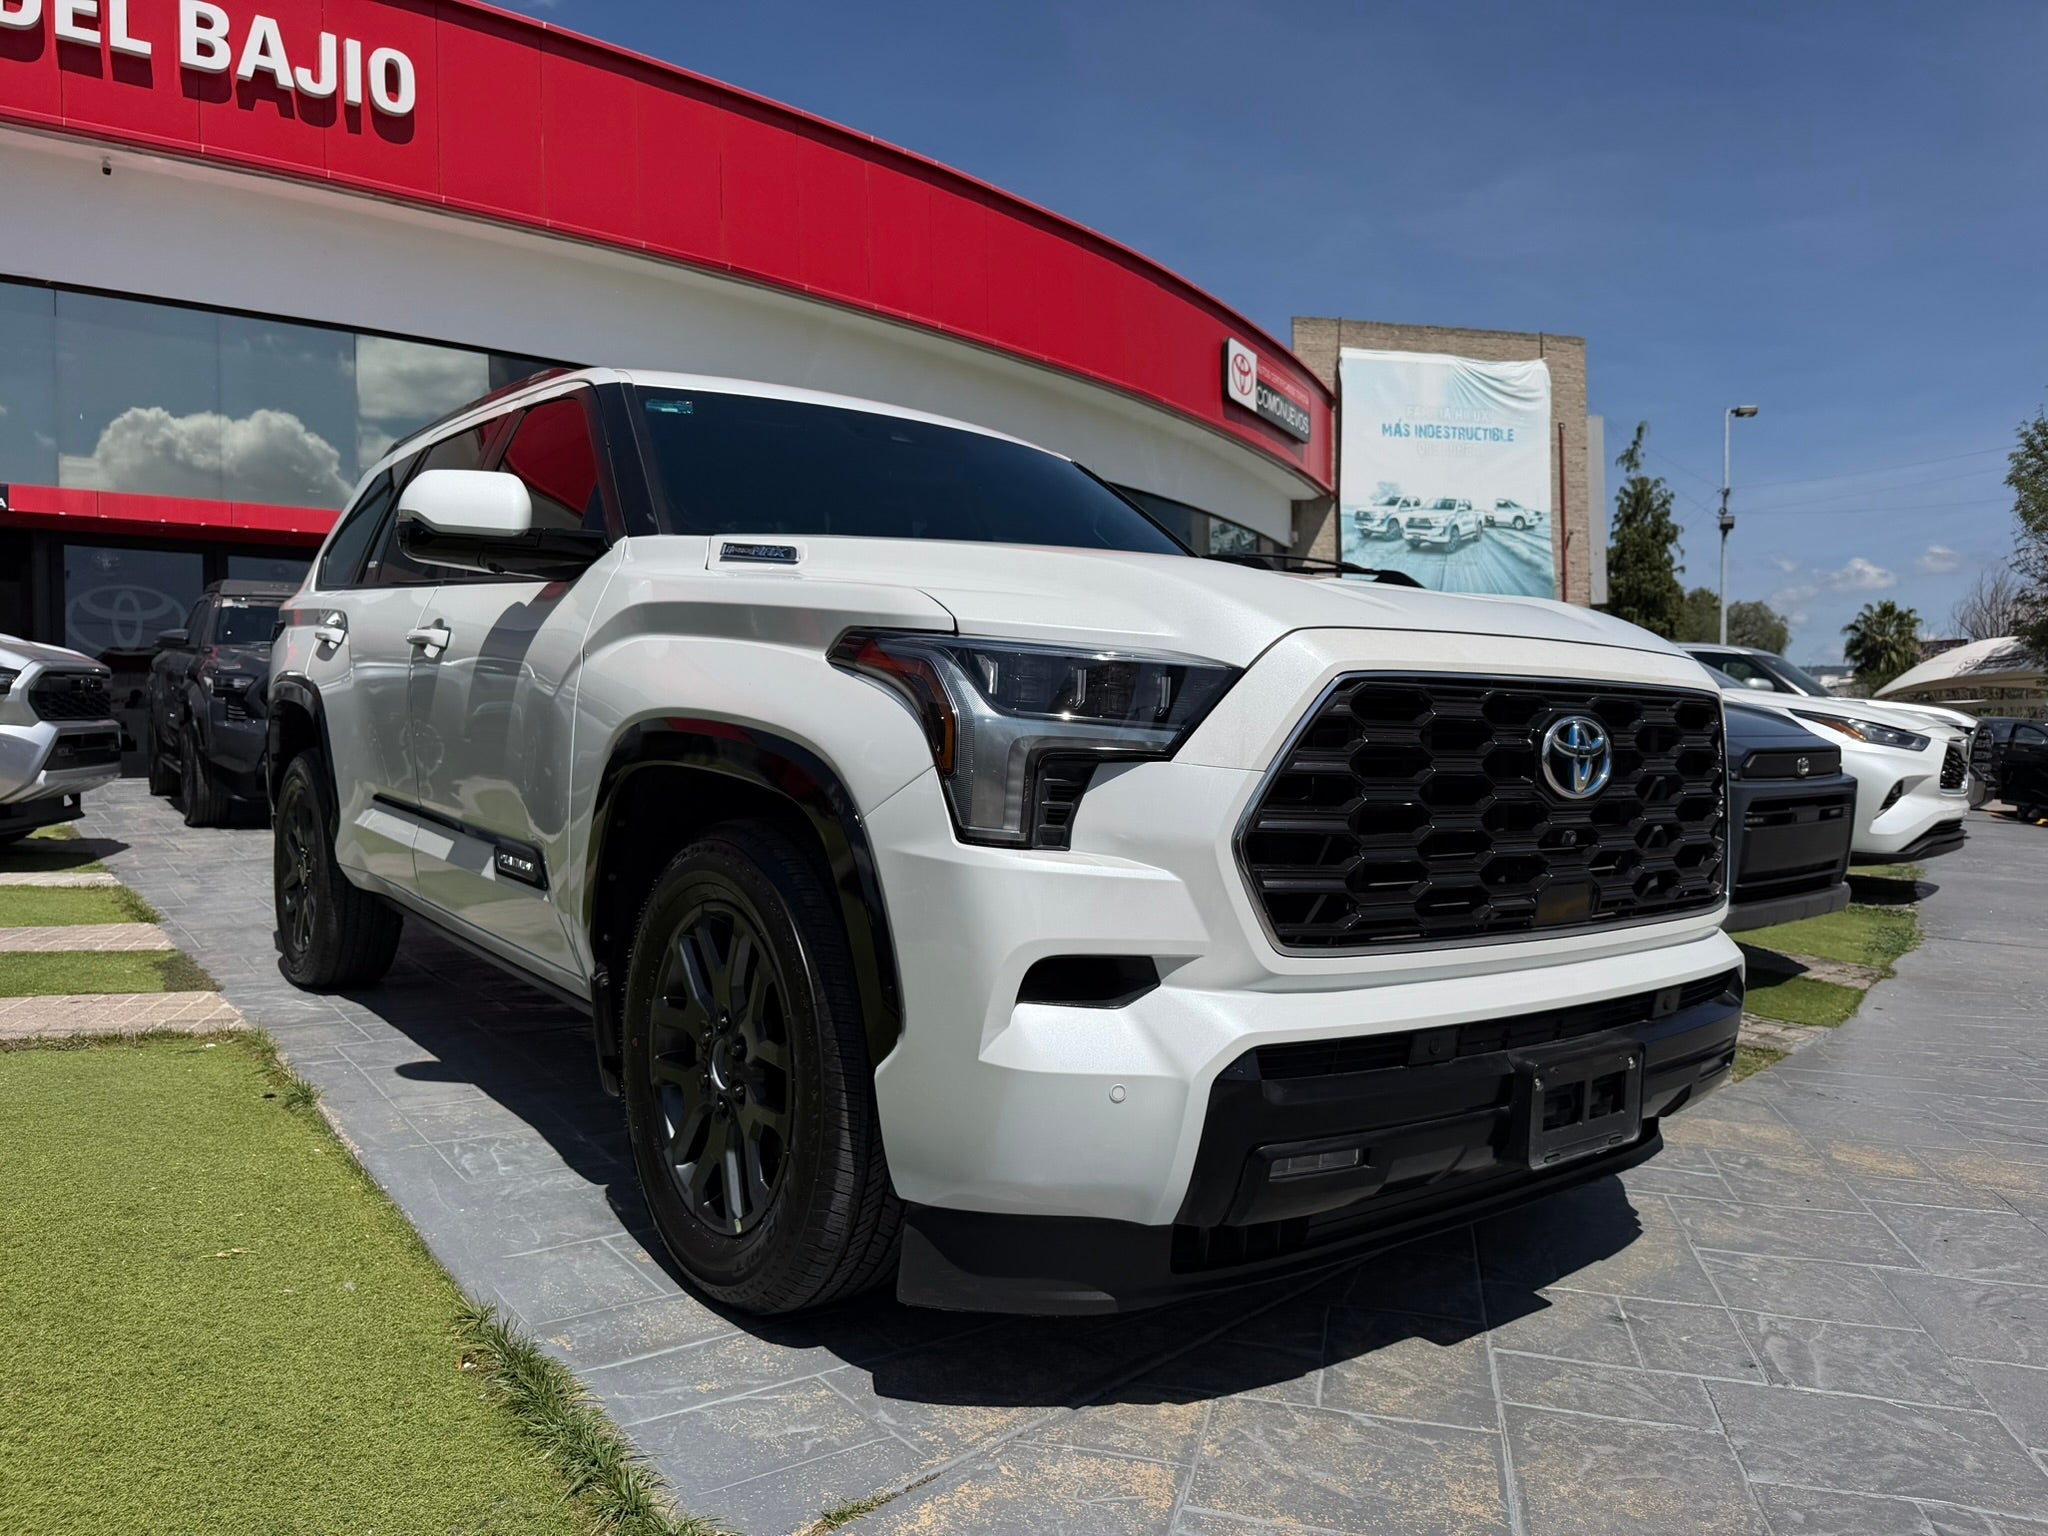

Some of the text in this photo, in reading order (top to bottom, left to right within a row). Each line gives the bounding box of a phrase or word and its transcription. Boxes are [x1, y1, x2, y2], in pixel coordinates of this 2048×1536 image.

[179, 0, 416, 115] BAJIO
[1256, 386, 1309, 434] COMONUEVOS
[1381, 417, 1515, 442] MÁS INDESTRUCTIBLE
